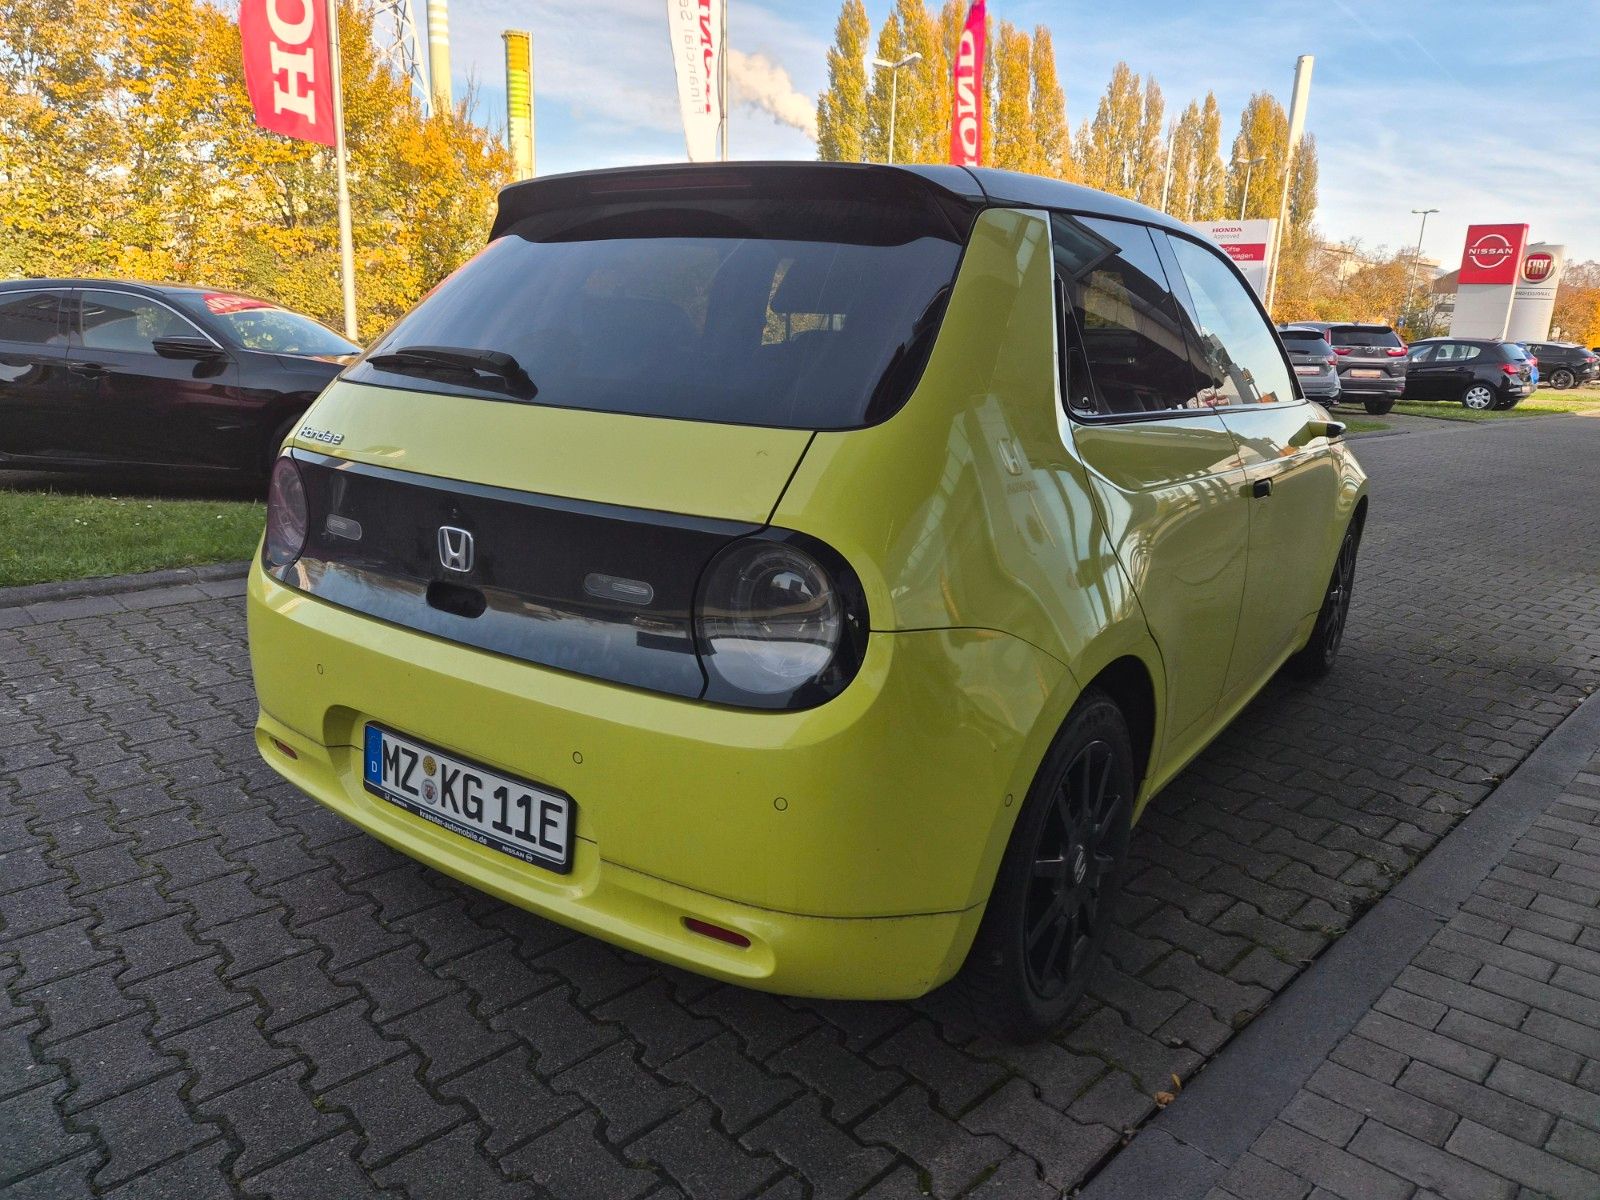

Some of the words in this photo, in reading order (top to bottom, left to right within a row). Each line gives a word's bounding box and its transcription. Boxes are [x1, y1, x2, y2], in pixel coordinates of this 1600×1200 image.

[1526, 259, 1551, 275] FIAT
[371, 760, 378, 773] D
[382, 738, 419, 796] MZ
[502, 845, 525, 859] NISSAN
